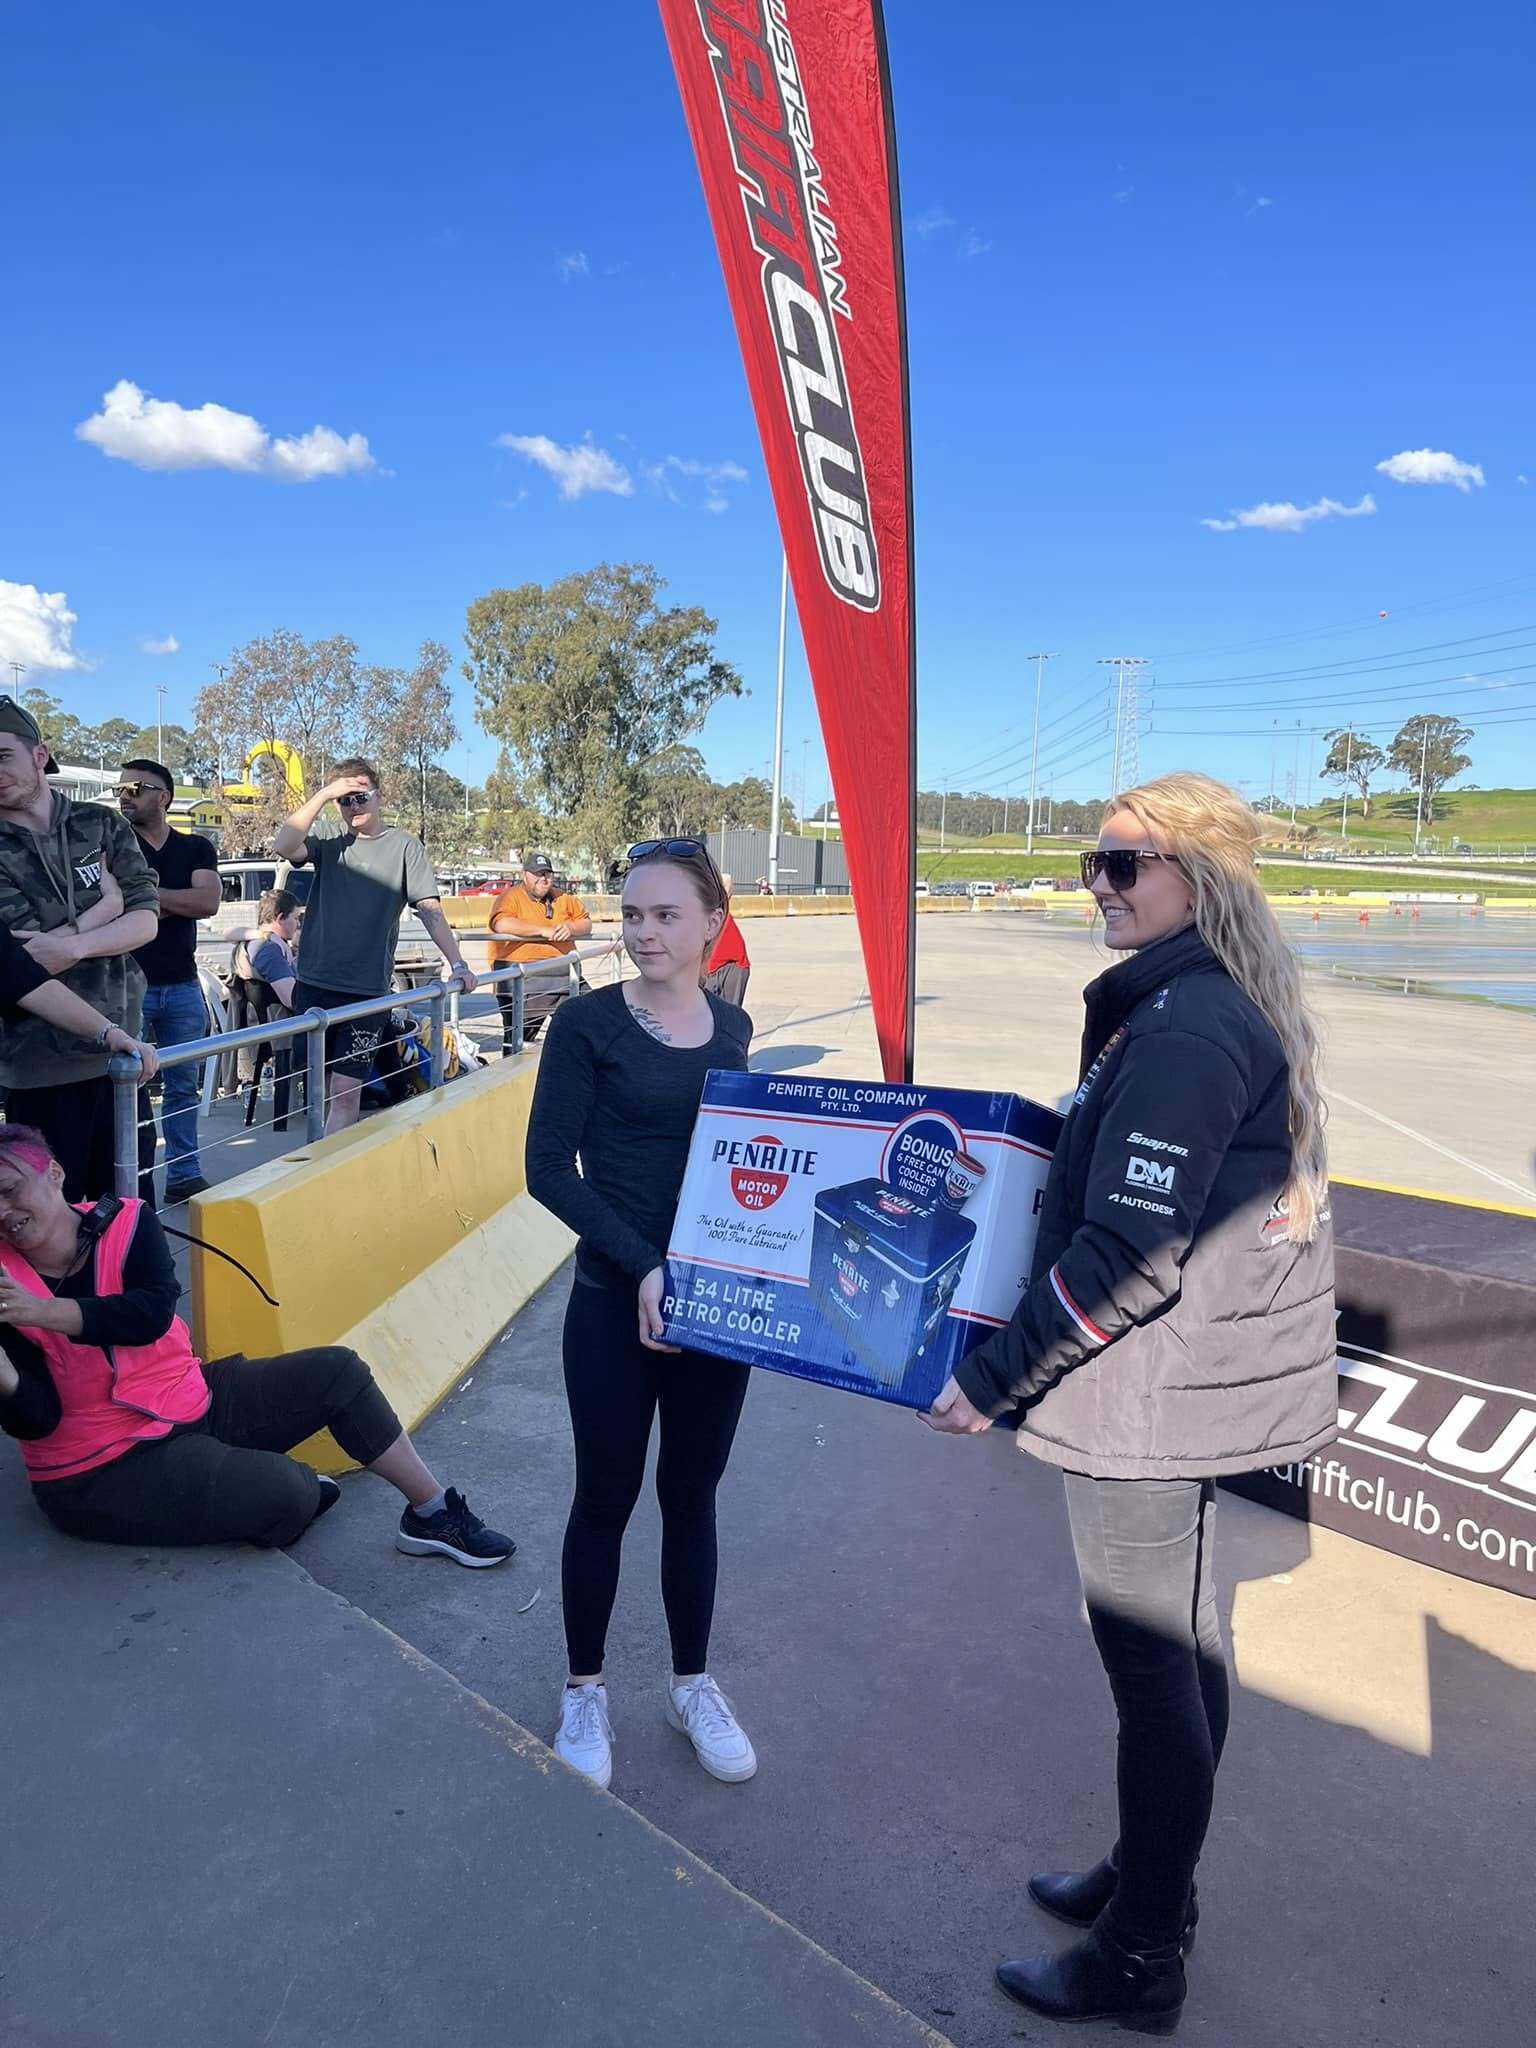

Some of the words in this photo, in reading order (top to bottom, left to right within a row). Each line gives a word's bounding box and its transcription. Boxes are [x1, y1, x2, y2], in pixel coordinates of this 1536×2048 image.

[766, 0, 849, 317] USTRALIAN
[770, 270, 876, 600] CLUB
[767, 1082, 824, 1098] PENRITE
[828, 1087, 850, 1100] OIL
[854, 1089, 927, 1107] COMPANY
[820, 1101, 839, 1111] PTY.
[842, 1103, 862, 1112] LTD.
[712, 1139, 818, 1175] PENRITE
[900, 1134, 954, 1167] BONUS
[1126, 1132, 1189, 1157] Snap-on
[896, 1153, 903, 1161] 6
[904, 1154, 926, 1171] FREE
[926, 1164, 945, 1178] CAN
[898, 1165, 937, 1187] COOLERS
[737, 1179, 778, 1195] MOTOR
[898, 1177, 930, 1196] INSIDE!
[745, 1194, 764, 1207] OIL
[875, 1189, 931, 1218] PENRITE
[1120, 1195, 1177, 1216] AUTODESK
[714, 1217, 729, 1229] Oil
[832, 1252, 871, 1294] PENRITE
[694, 1278, 718, 1298] 54
[722, 1284, 777, 1312] LITRE
[663, 1295, 721, 1324] RETRO
[726, 1310, 801, 1344] COOLER
[1263, 1456, 1536, 1573] riftclub.com
